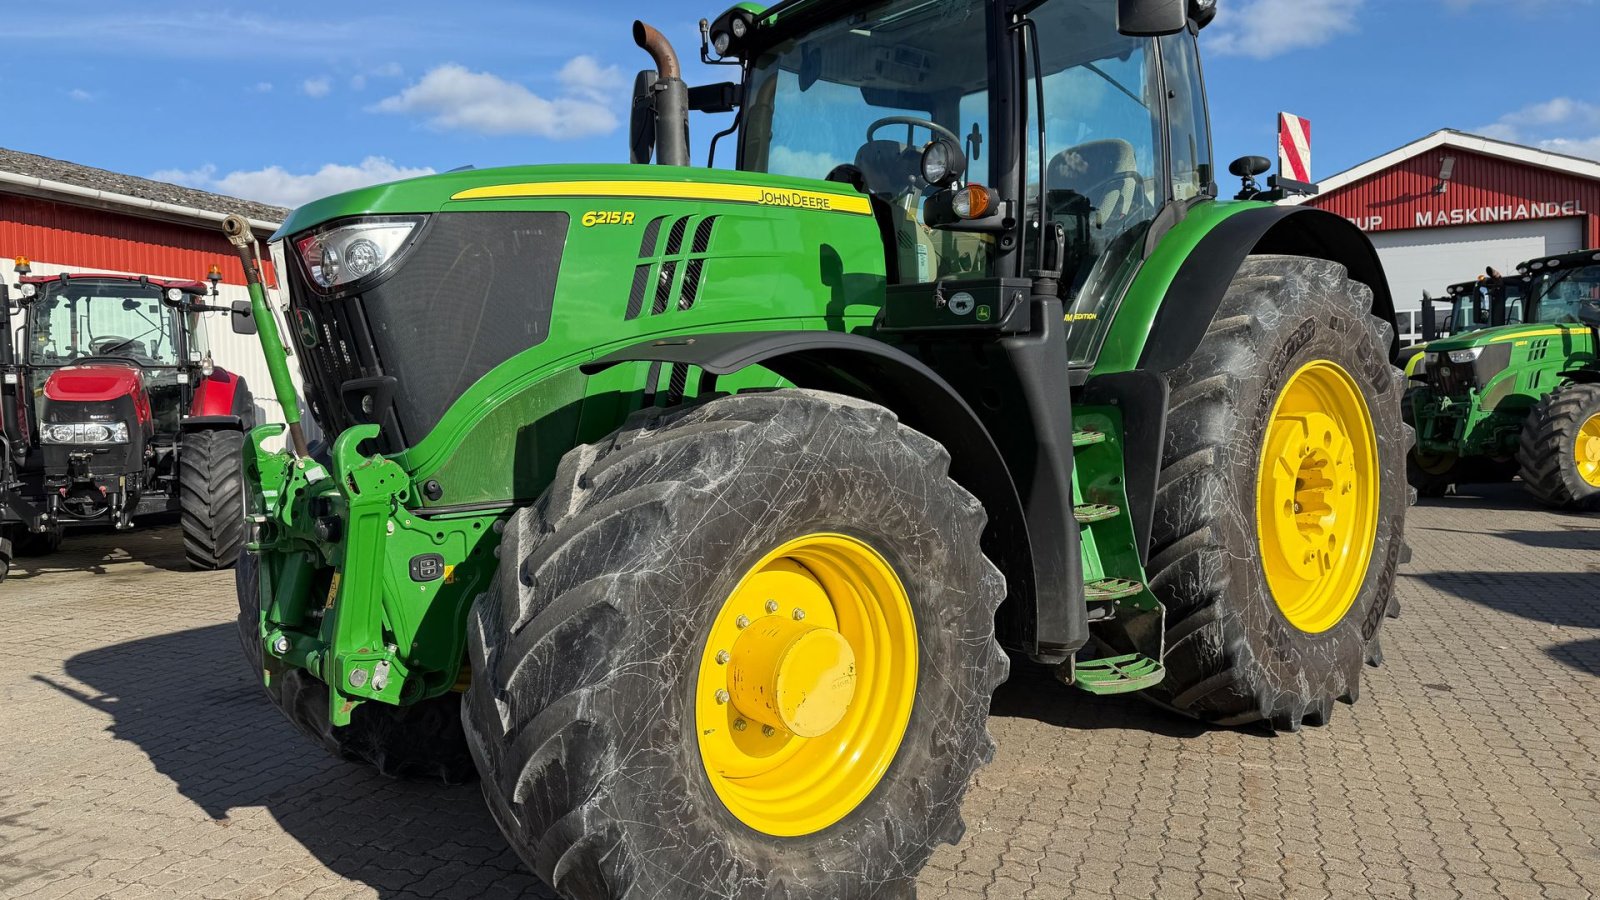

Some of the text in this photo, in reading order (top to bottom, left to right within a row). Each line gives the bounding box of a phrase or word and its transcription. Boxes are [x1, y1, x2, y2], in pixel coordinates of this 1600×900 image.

[758, 189, 832, 209] JOHN DEERE
[1415, 199, 1587, 227] MASKINHANDEL
